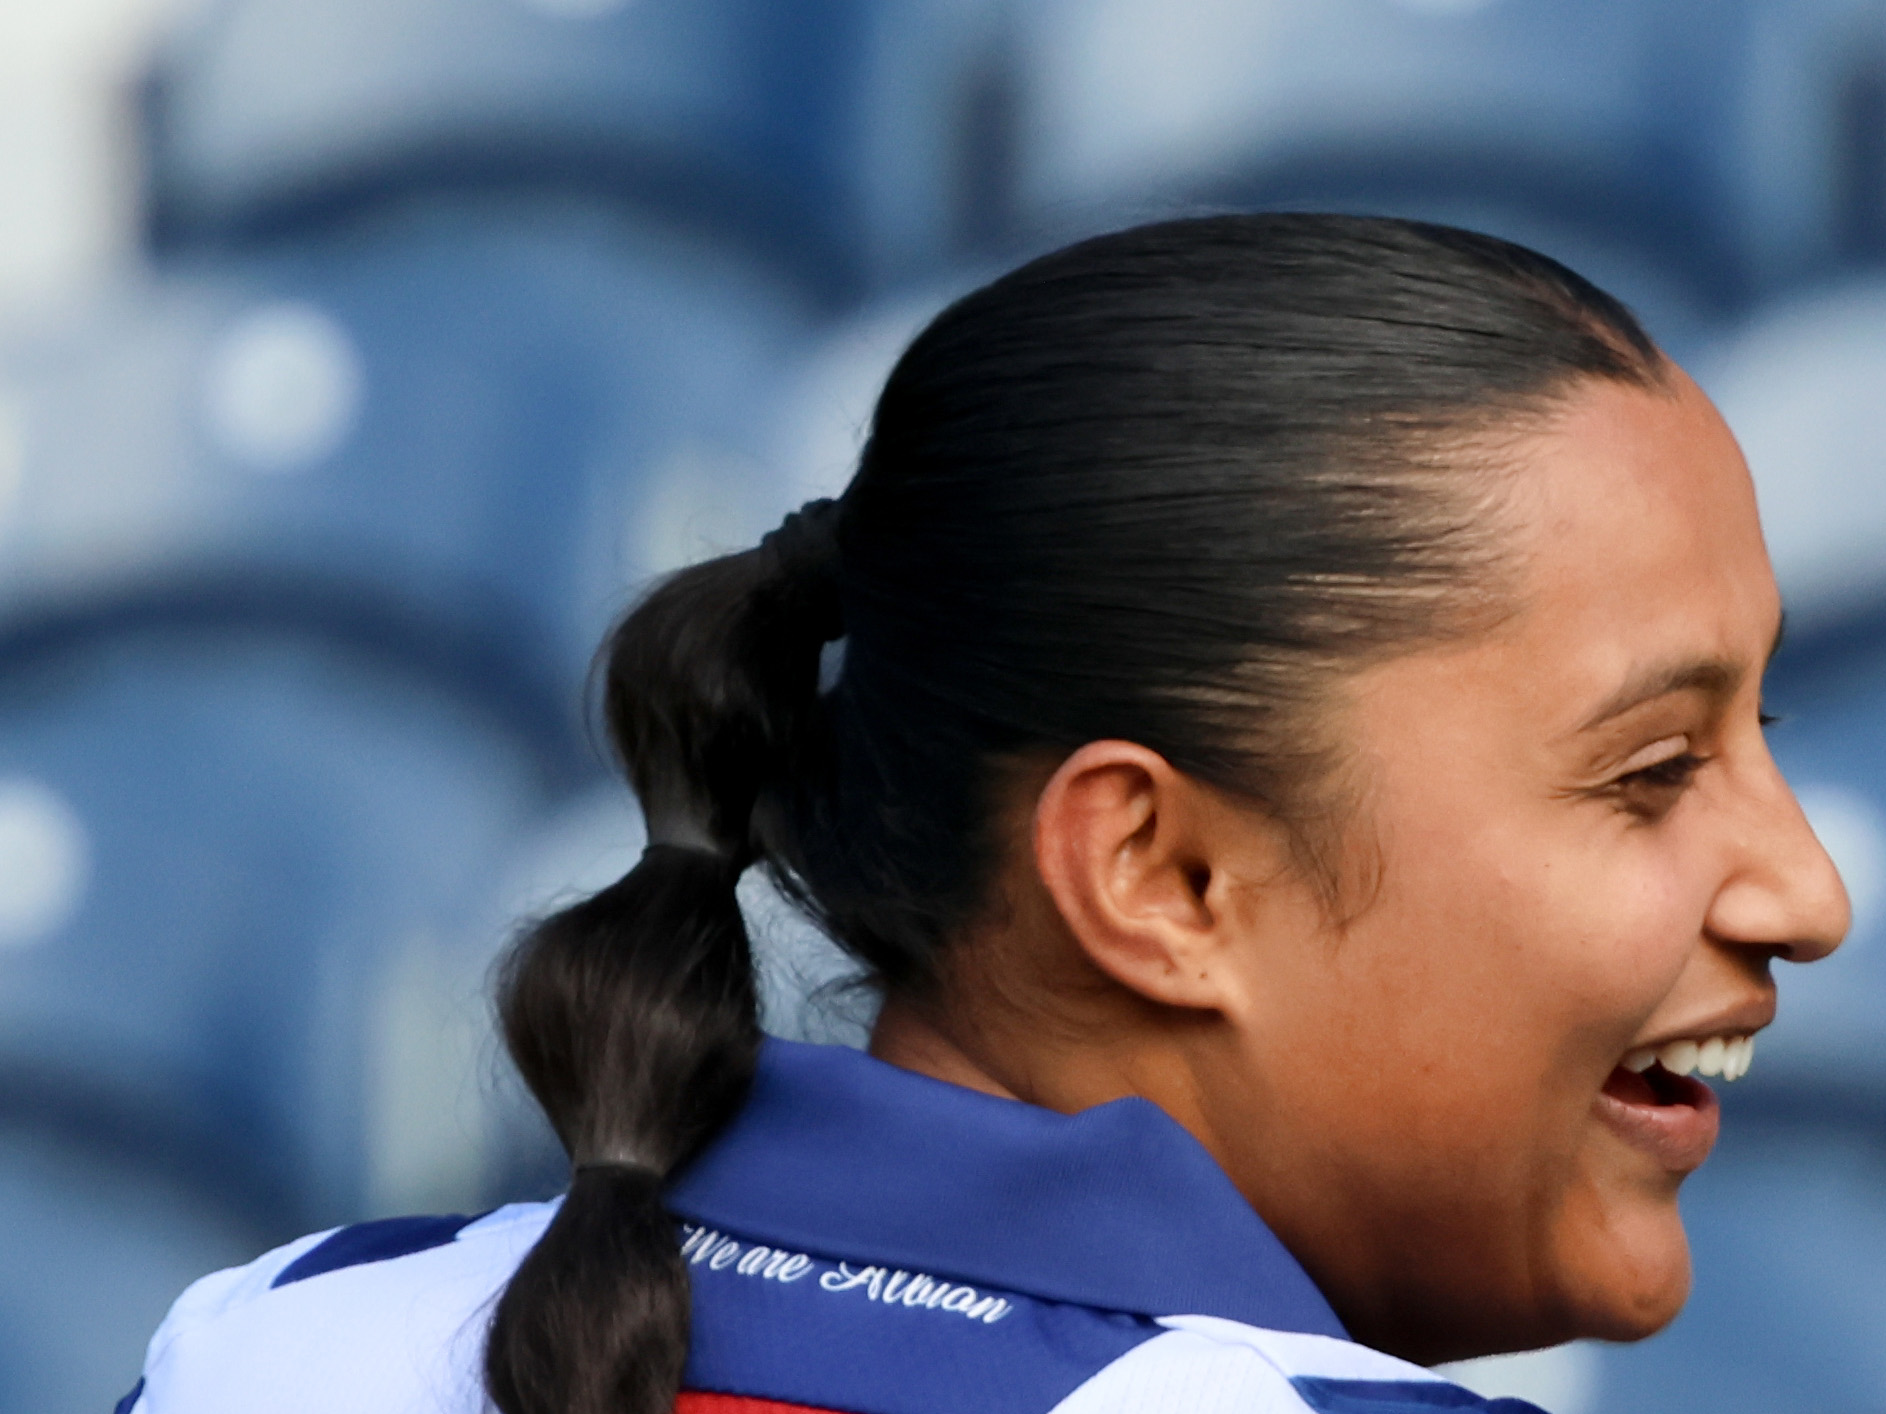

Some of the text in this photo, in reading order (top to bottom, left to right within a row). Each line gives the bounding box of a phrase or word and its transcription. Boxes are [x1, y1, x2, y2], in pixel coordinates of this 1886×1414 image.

[680, 1223, 1013, 1324] We are Albion
